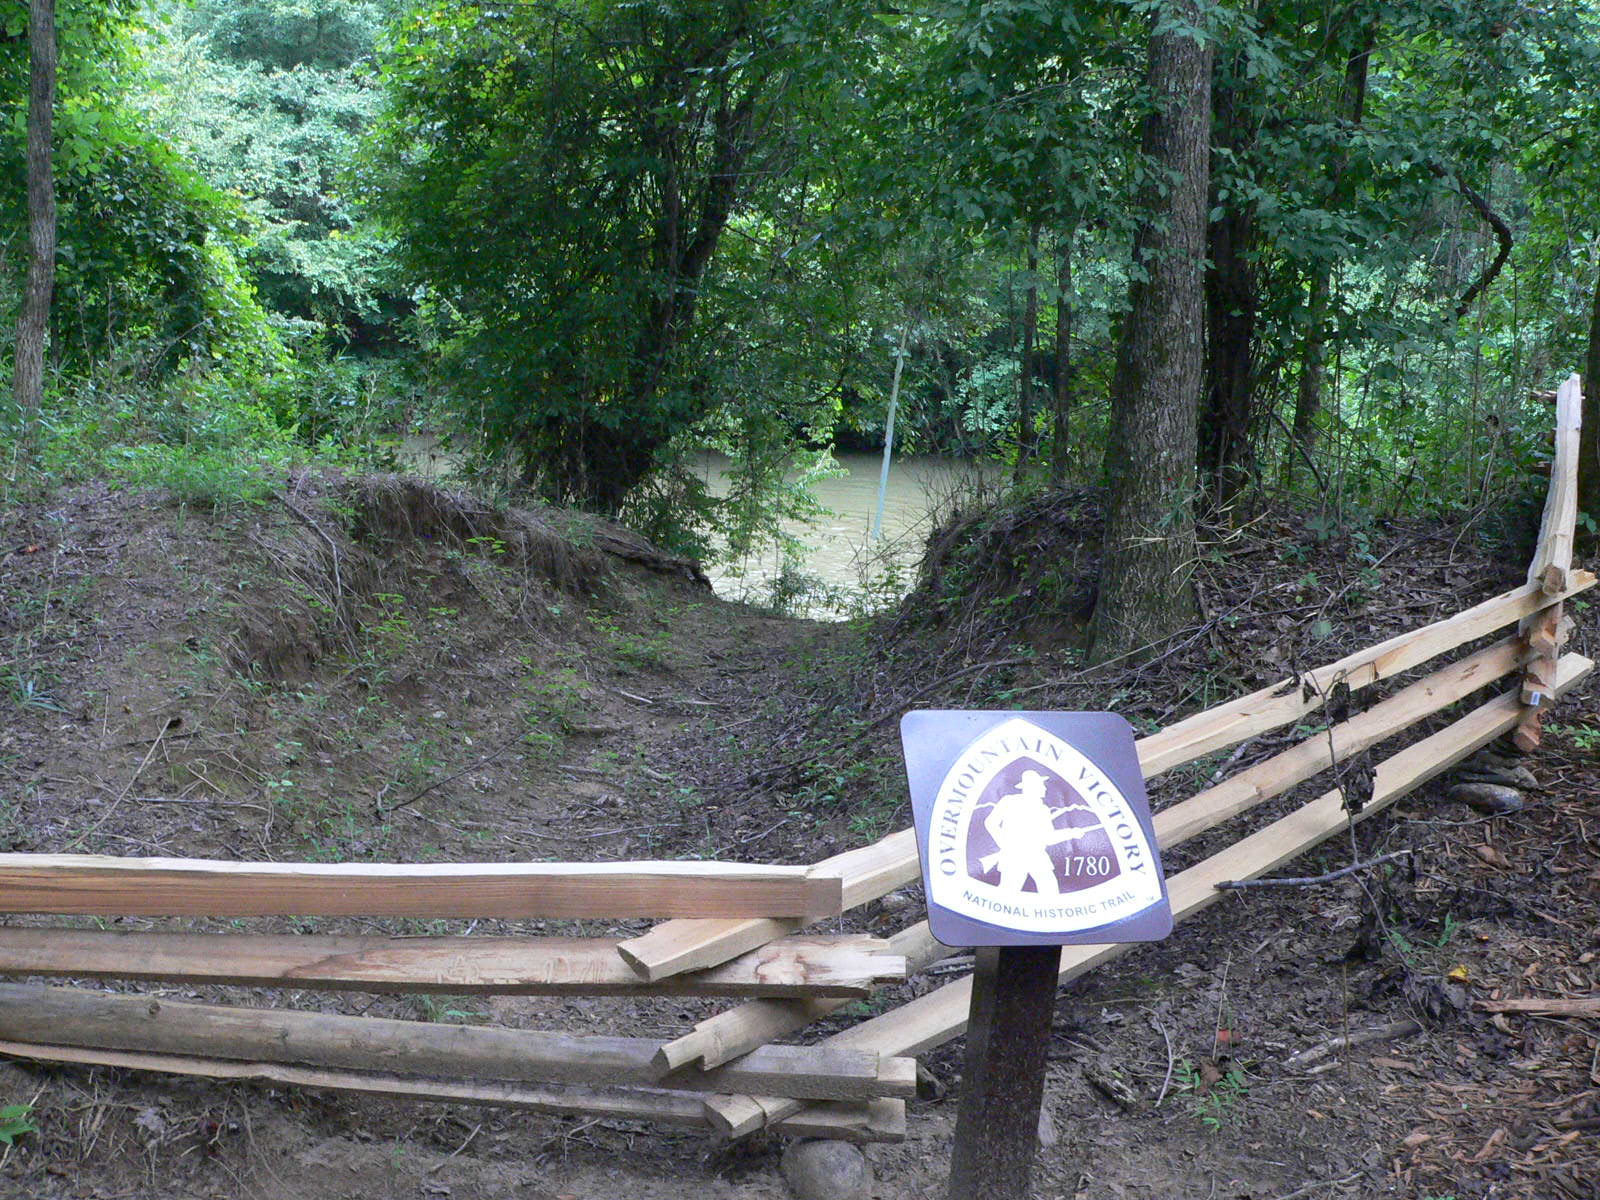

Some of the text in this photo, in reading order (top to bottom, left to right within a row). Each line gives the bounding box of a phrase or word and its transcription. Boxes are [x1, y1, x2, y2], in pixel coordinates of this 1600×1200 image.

[939, 736, 1147, 877] OVERMOUNTAIN VICTORY
[1063, 855, 1111, 877] 1780
[962, 889, 1136, 919] NATIONAL HISTORIC TRAIL
